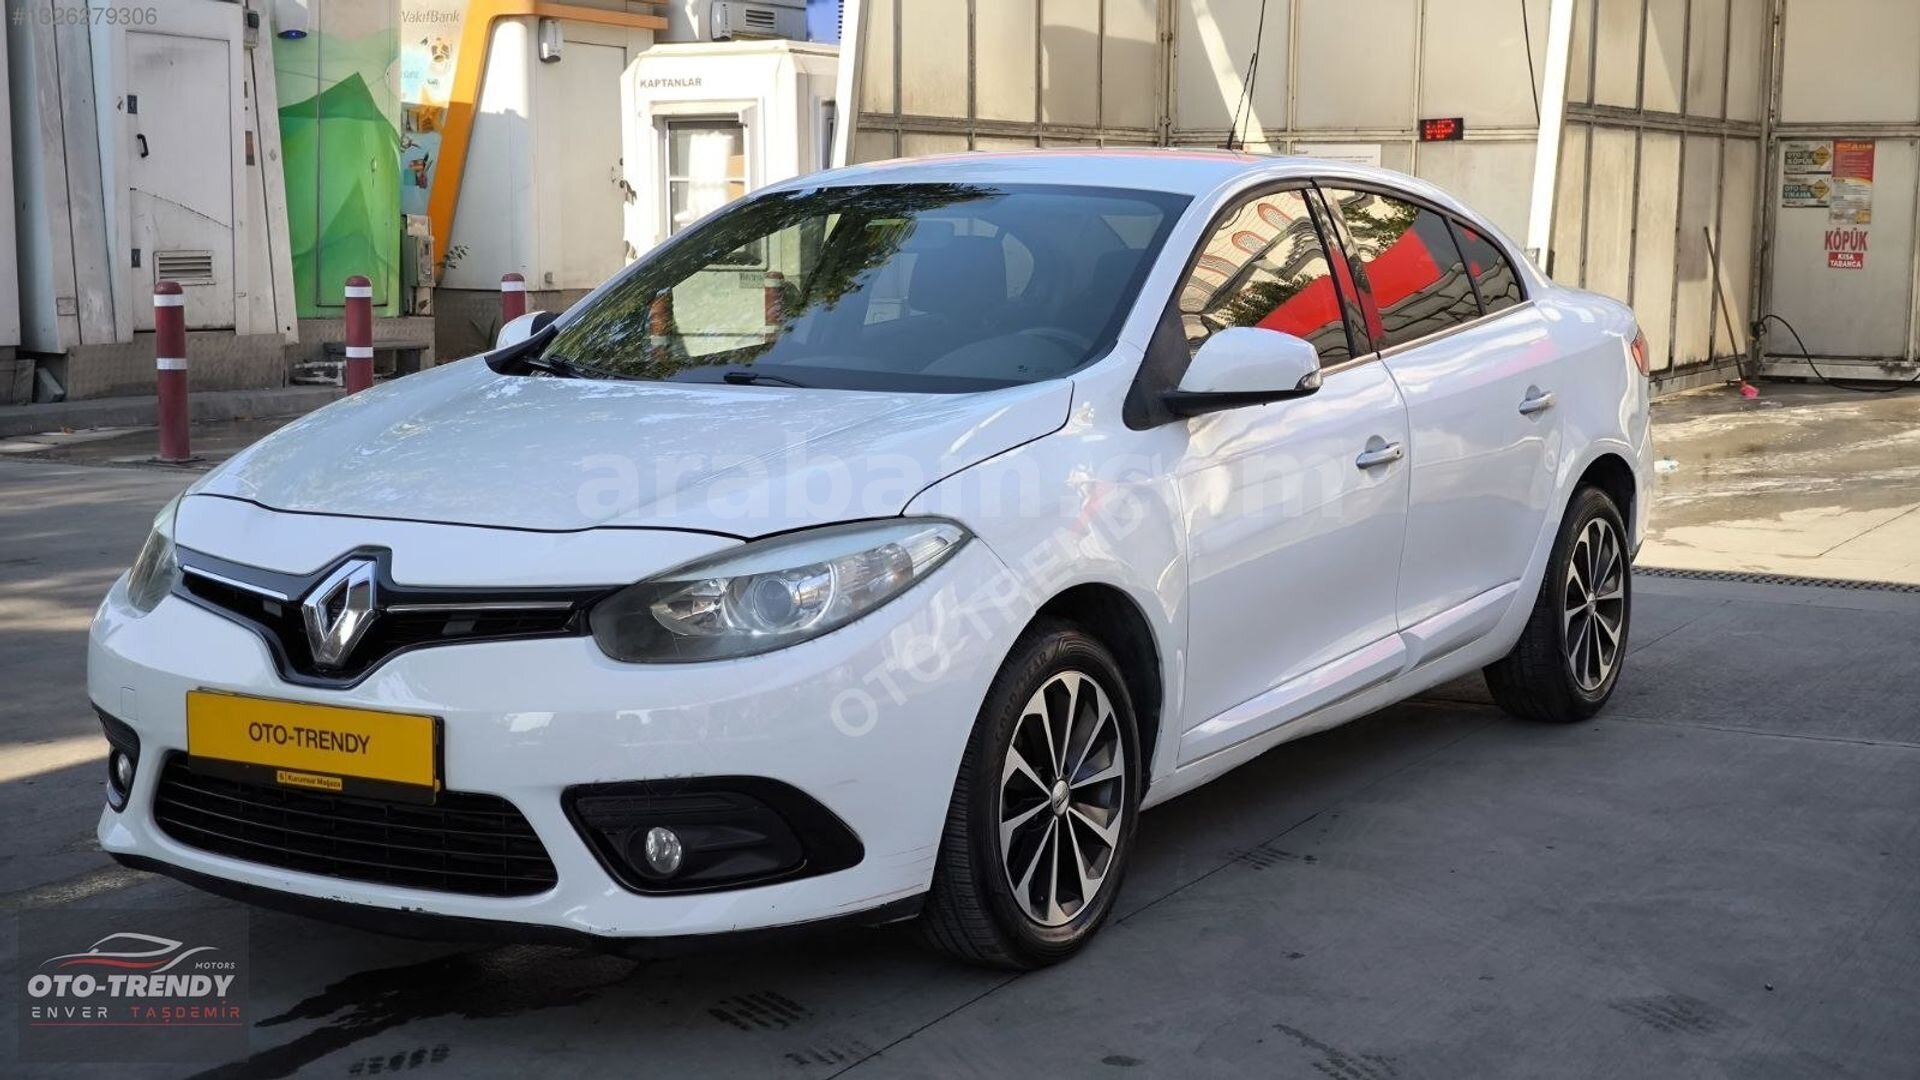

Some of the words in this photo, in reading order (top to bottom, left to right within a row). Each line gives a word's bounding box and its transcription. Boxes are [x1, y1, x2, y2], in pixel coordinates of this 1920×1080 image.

[640, 78, 702, 89] KAPTANLAR
[1824, 227, 1868, 251] KÖPÜK
[1830, 260, 1862, 268] TABANCA
[249, 722, 371, 755] OTO-TRENDY
